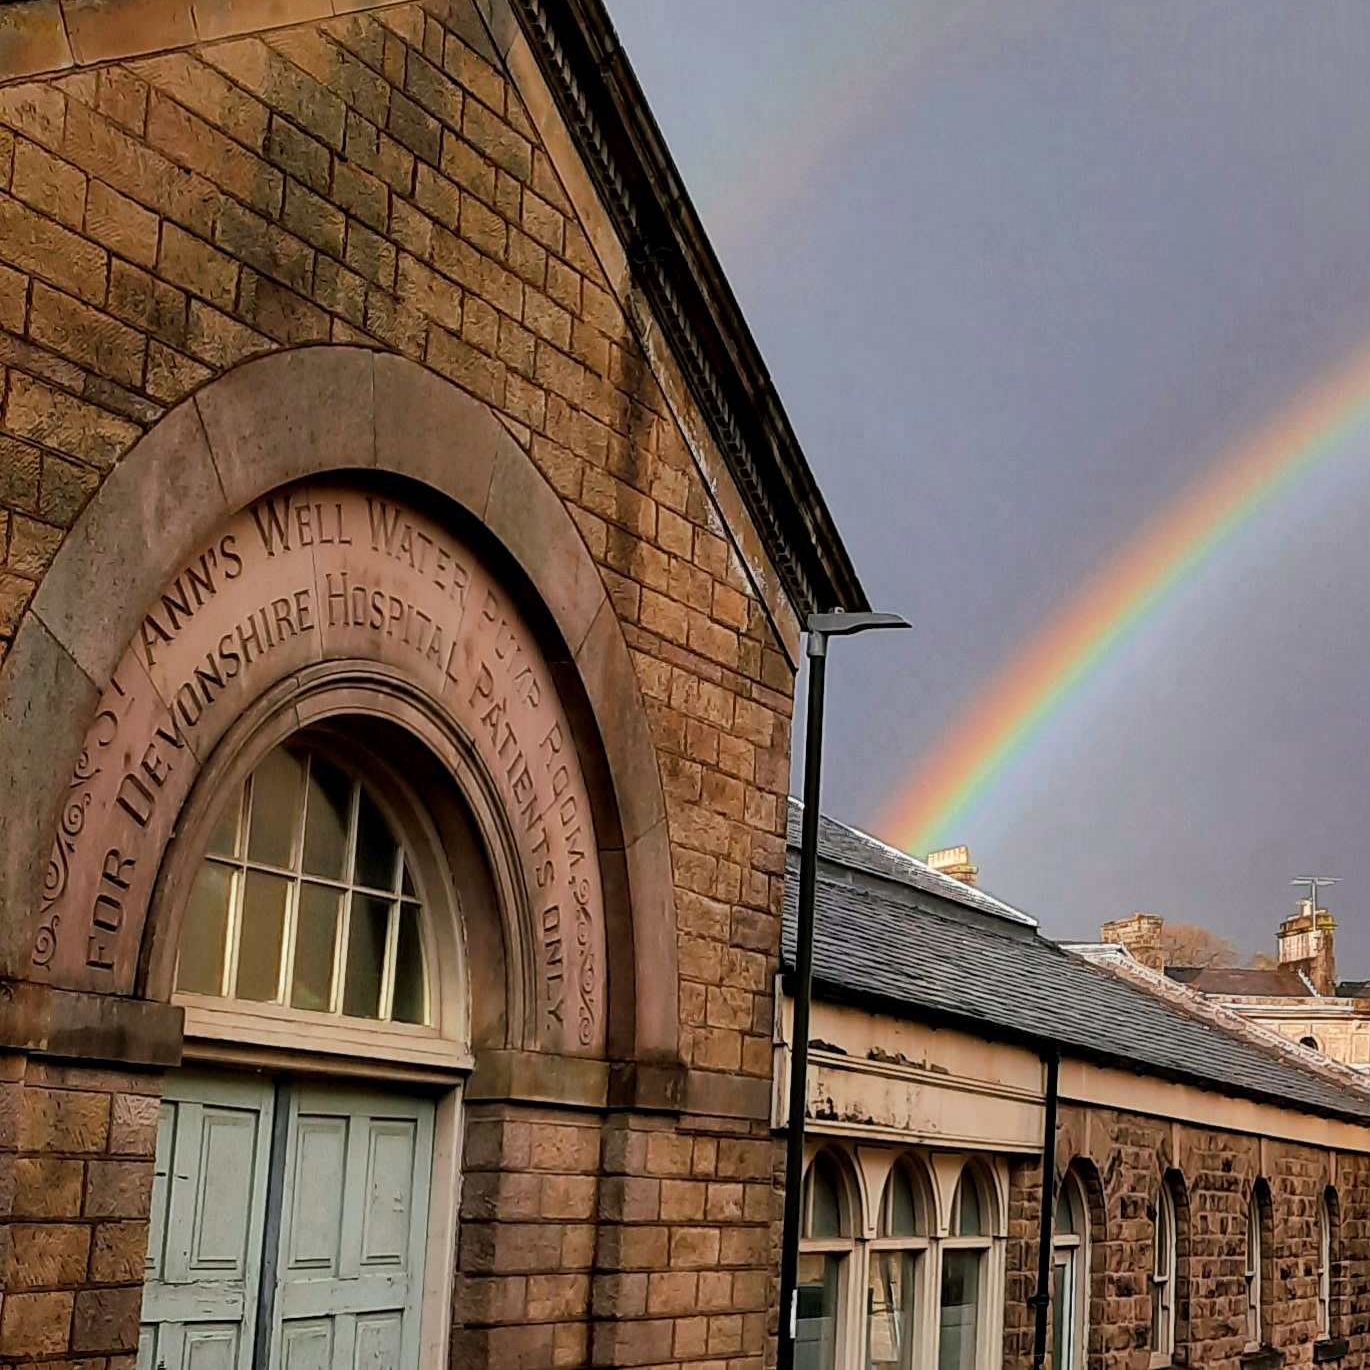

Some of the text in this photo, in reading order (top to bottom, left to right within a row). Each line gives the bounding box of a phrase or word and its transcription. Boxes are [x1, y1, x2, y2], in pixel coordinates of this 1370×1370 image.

[139, 534, 243, 666] ANN'S
[250, 495, 352, 557] WELL
[366, 497, 470, 610] WATER
[477, 588, 541, 709] PUMP
[86, 848, 136, 970] FOR
[116, 588, 315, 827] DEVONSHIRE
[325, 571, 458, 683] HOSPITAL
[467, 660, 556, 889] PATIENTS
